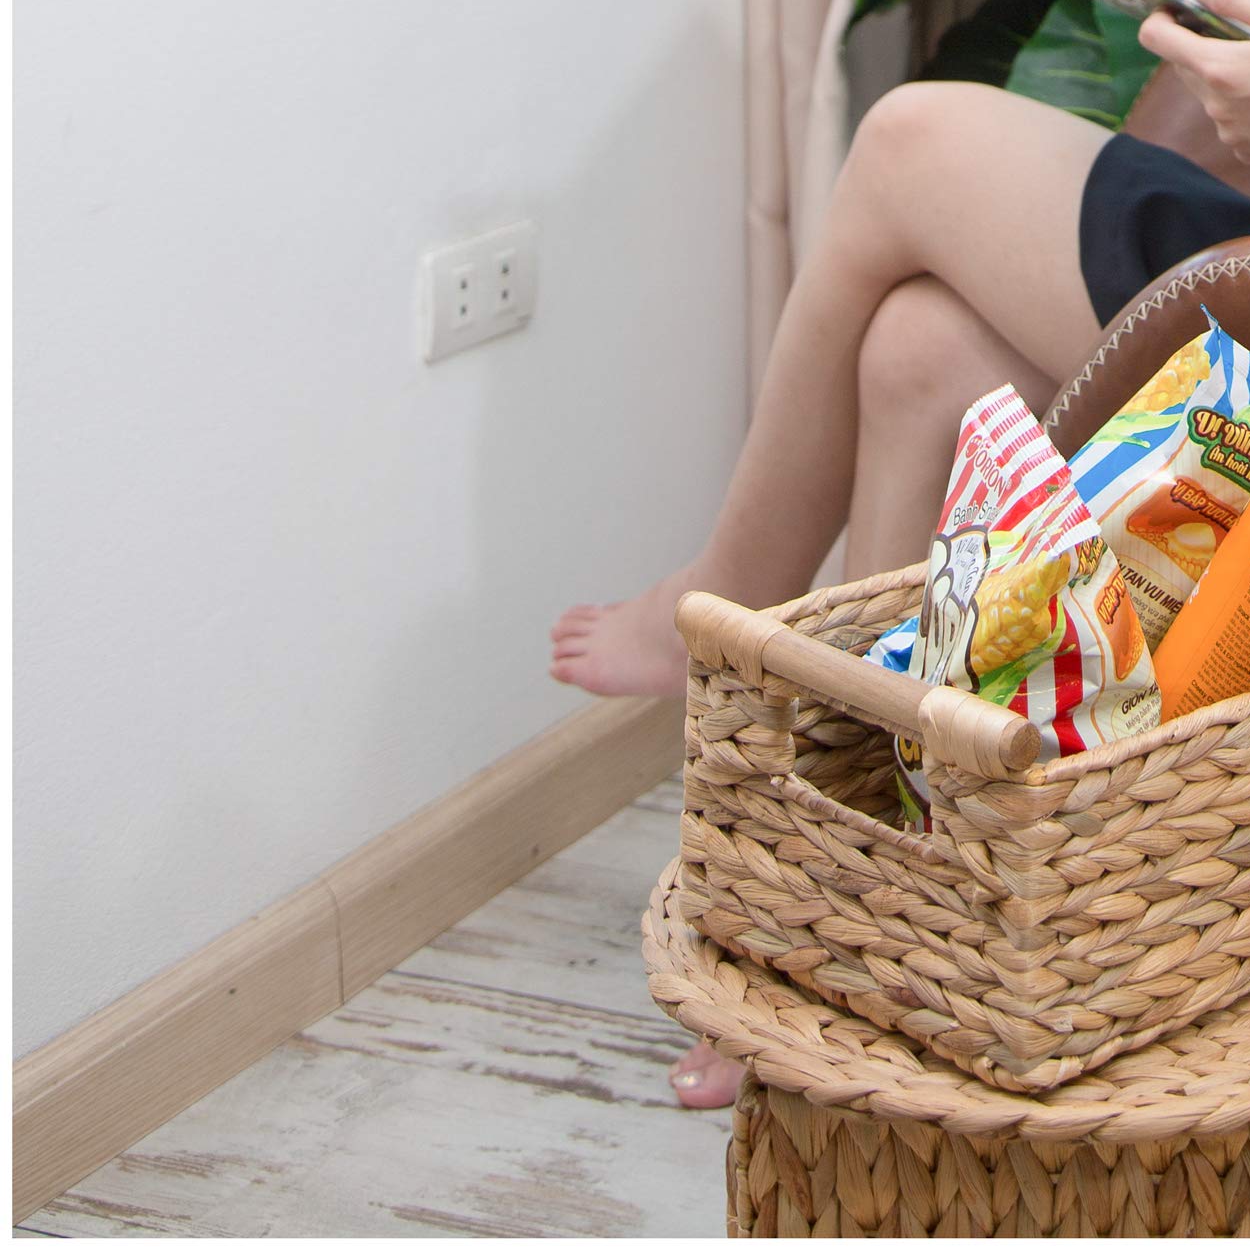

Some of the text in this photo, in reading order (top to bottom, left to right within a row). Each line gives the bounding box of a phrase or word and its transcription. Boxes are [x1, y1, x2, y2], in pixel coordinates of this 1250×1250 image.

[975, 449, 1007, 498] ORION
[1123, 568, 1184, 614] TAN VUI MIỆ
